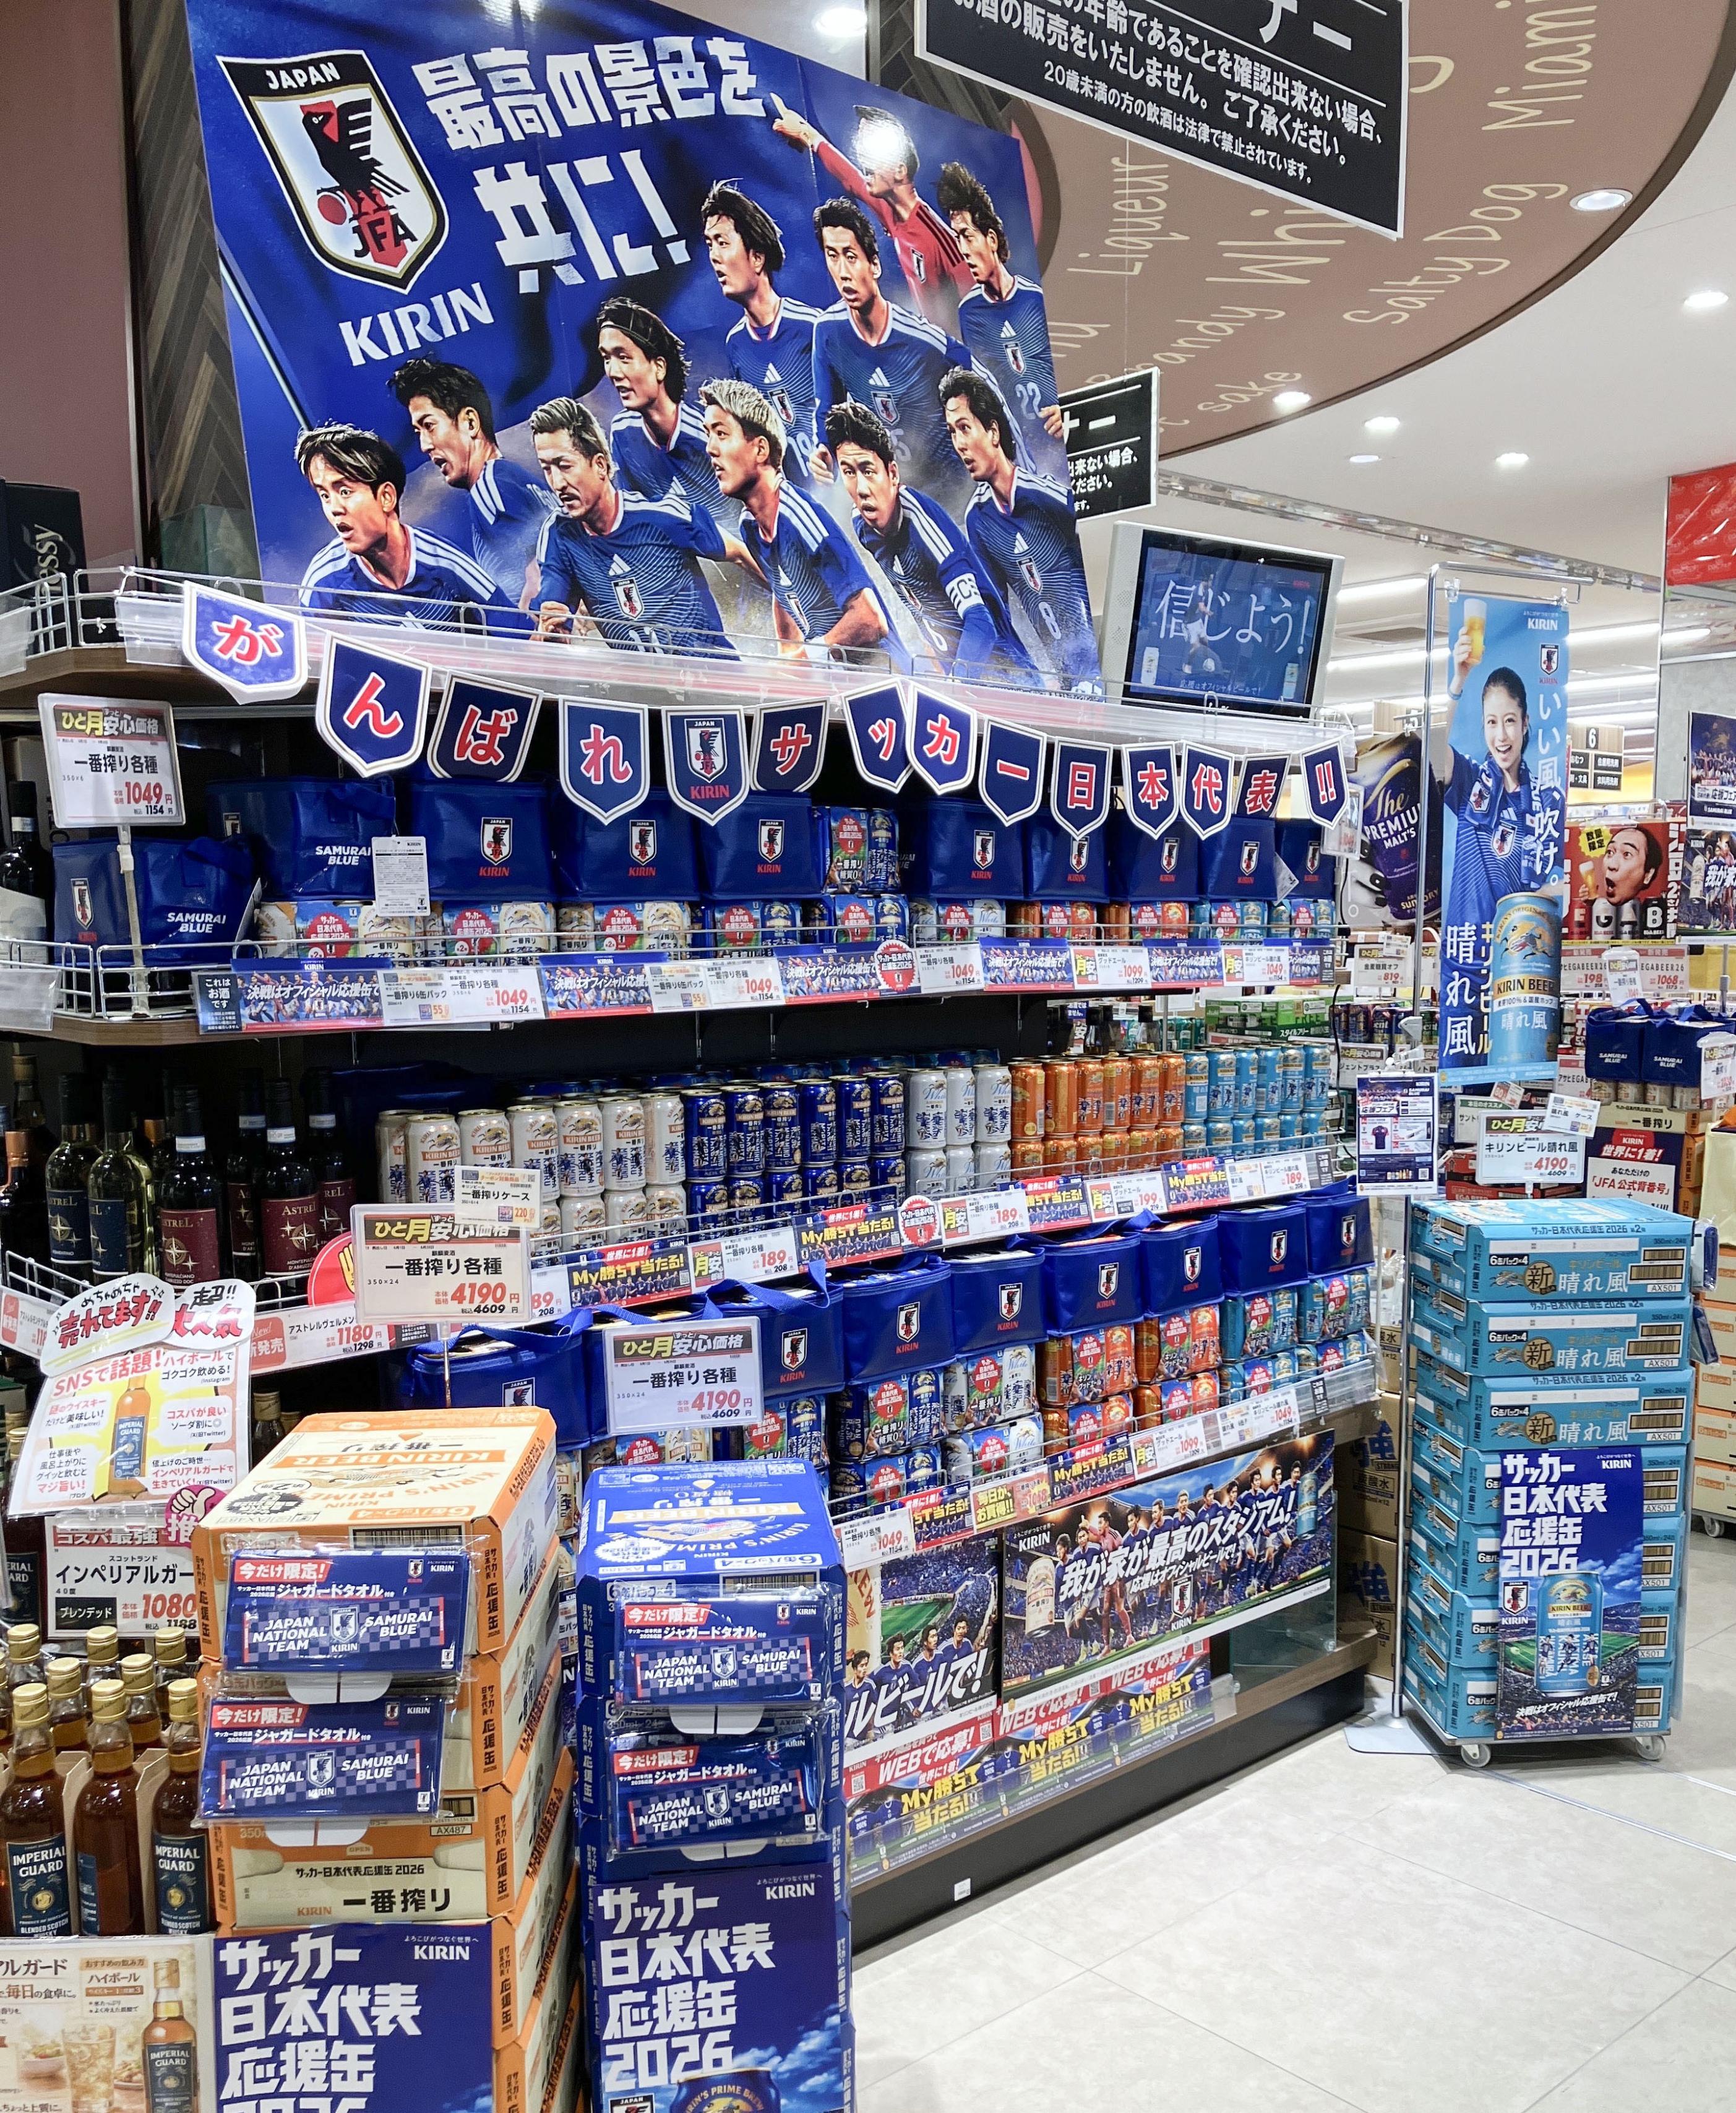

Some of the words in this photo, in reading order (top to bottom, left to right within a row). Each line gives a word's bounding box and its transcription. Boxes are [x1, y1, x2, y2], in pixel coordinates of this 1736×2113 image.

[265, 62, 340, 92] JAPAN
[1051, 0, 1383, 144] の年齢であることを確認出来ない場合、
[411, 37, 766, 151] 最高の景色を
[1044, 61, 1312, 184] 20歳未満の方の飲酒は法律で禁止されています。
[1223, 89, 1346, 165] ご了承ください。
[1067, 156, 1190, 276] Liqueur
[1423, 183, 1569, 242] Dog
[473, 149, 691, 294] 共に!
[1343, 256, 1511, 324] Salty
[338, 283, 494, 366] KIRIN
[1528, 618, 1558, 630] KIRIN
[1589, 728, 1596, 748] 6
[74, 754, 158, 774] 一番搾り各種
[125, 781, 163, 804] 1049
[690, 785, 729, 799] KIRIN
[145, 805, 164, 815] 1154
[328, 855, 359, 866] BLUE
[479, 866, 510, 877] KIRIN
[629, 866, 656, 876] KIRIN
[757, 864, 781, 874] KIRIN
[167, 913, 226, 924] SAMURAI
[179, 923, 213, 933] BLUE
[205, 979, 231, 988] これは
[451, 979, 499, 989] 一番搾り各種
[1443, 922, 1477, 1057] 晴れ風
[1497, 978, 1524, 994] KIRIN
[208, 989, 230, 999] お酒
[496, 989, 528, 1006] 1049
[211, 1001, 228, 1009] です
[510, 1005, 530, 1013] 1154
[1501, 1010, 1547, 1030] 晴れ風
[1631, 1117, 1672, 1129] 一番搾り
[1485, 1142, 1578, 1153] キリンビール晴れ風
[1622, 1137, 1643, 1145] KIRIN
[1601, 1145, 1663, 1161] 世界に1着!
[1534, 1158, 1568, 1171] 4190
[1611, 1167, 1650, 1177] あなただけの
[462, 1190, 530, 1202] 一番搾りケース
[514, 1207, 528, 1219] 220
[996, 1208, 1018, 1223] 189
[761, 1250, 787, 1267] 189
[385, 1257, 502, 1276] 一番搾り各種
[1558, 1272, 1628, 1294] 晴れ風
[450, 1281, 507, 1304] 4190
[473, 1304, 505, 1314] 4609
[997, 1320, 1020, 1330] KIRIN
[337, 1325, 373, 1345] 1180
[354, 1341, 374, 1351] 1298
[896, 1341, 919, 1354] KIRIN
[1557, 1347, 1626, 1371] 晴れ風
[161, 1365, 231, 1380] ゴクゴク飲める!
[633, 1367, 737, 1388] 一番搾り各種
[780, 1371, 806, 1383] KIRIN
[692, 1388, 741, 1409] 4190
[167, 1406, 227, 1419] コスパが良い
[711, 1409, 740, 1418] 4609
[1559, 1421, 1629, 1443] 晴れ風
[1503, 1453, 1575, 1484] サッカー
[1602, 1460, 1632, 1469] KIRIN
[1503, 1483, 1608, 1516] 日本代表
[1502, 1517, 1583, 1547] 応援缶
[1019, 1531, 1051, 1552] KIRIN
[1059, 1492, 1295, 1599] 我が家が最高のスタジアム!
[430, 1564, 455, 1573] KIRIN
[1501, 1547, 1579, 1577] 2026
[239, 1561, 325, 1580] 今だけ限定!
[59, 1606, 113, 1620] ブレンデッド
[364, 1611, 432, 1627] SAMURAI
[627, 1607, 707, 1623] 今だけ限定!
[796, 1607, 817, 1616] KIRIN
[264, 1616, 314, 1630] JAPAN
[1171, 1617, 1192, 1630] KIRIN
[1502, 1617, 1528, 1625] KIRIN
[252, 1626, 327, 1643] NATIONAL
[379, 1625, 418, 1637] BLUE
[268, 1639, 309, 1653] TEAM
[331, 1643, 359, 1653] KIRIN
[655, 1656, 698, 1669] JAPAN
[742, 1650, 801, 1665] SAMURAI
[644, 1664, 710, 1679] NATIONAL
[755, 1660, 788, 1672] BLUE
[658, 1676, 695, 1688] TEAM
[713, 1678, 738, 1687] KIRIN
[217, 1707, 303, 1727] 今だけ限定!
[407, 1705, 431, 1715] KIRIN
[785, 1739, 806, 1747] KIRIN
[341, 1754, 409, 1771] SAMURAI
[618, 1749, 695, 1769] 今だけ限定!
[241, 1762, 291, 1776] JAPAN
[356, 1767, 393, 1780] BLUE
[230, 1770, 304, 1788] NATIONAL
[244, 1783, 286, 1797] TEAM
[734, 1783, 793, 1803] SAMURAI
[647, 1797, 691, 1813] JAPAN
[749, 1795, 781, 1809] BLUE
[639, 1805, 704, 1823] NATIONAL
[436, 1827, 466, 1835] AX487
[653, 1818, 689, 1832] TEAM
[13, 1846, 66, 1866] IMPERIAL
[19, 1861, 63, 1878] GUARD
[158, 1859, 196, 1872] GUARD
[766, 1883, 815, 1900] KIRIN
[343, 1887, 450, 1913] 一番搾り
[297, 1906, 332, 1917] KIRIN
[598, 1882, 720, 1934] サッカー
[414, 1943, 470, 1961] KIRIN
[600, 1922, 776, 1987] 日本代表
[220, 1933, 362, 1990] サッカー
[87, 1972, 140, 1984] ハイボール
[221, 1982, 423, 2042] 日本代表
[603, 1979, 736, 2040] 応援缶
[223, 2041, 376, 2095] 応援缶
[604, 2030, 734, 2093] 2026
[620, 2096, 643, 2104] JAPAN
